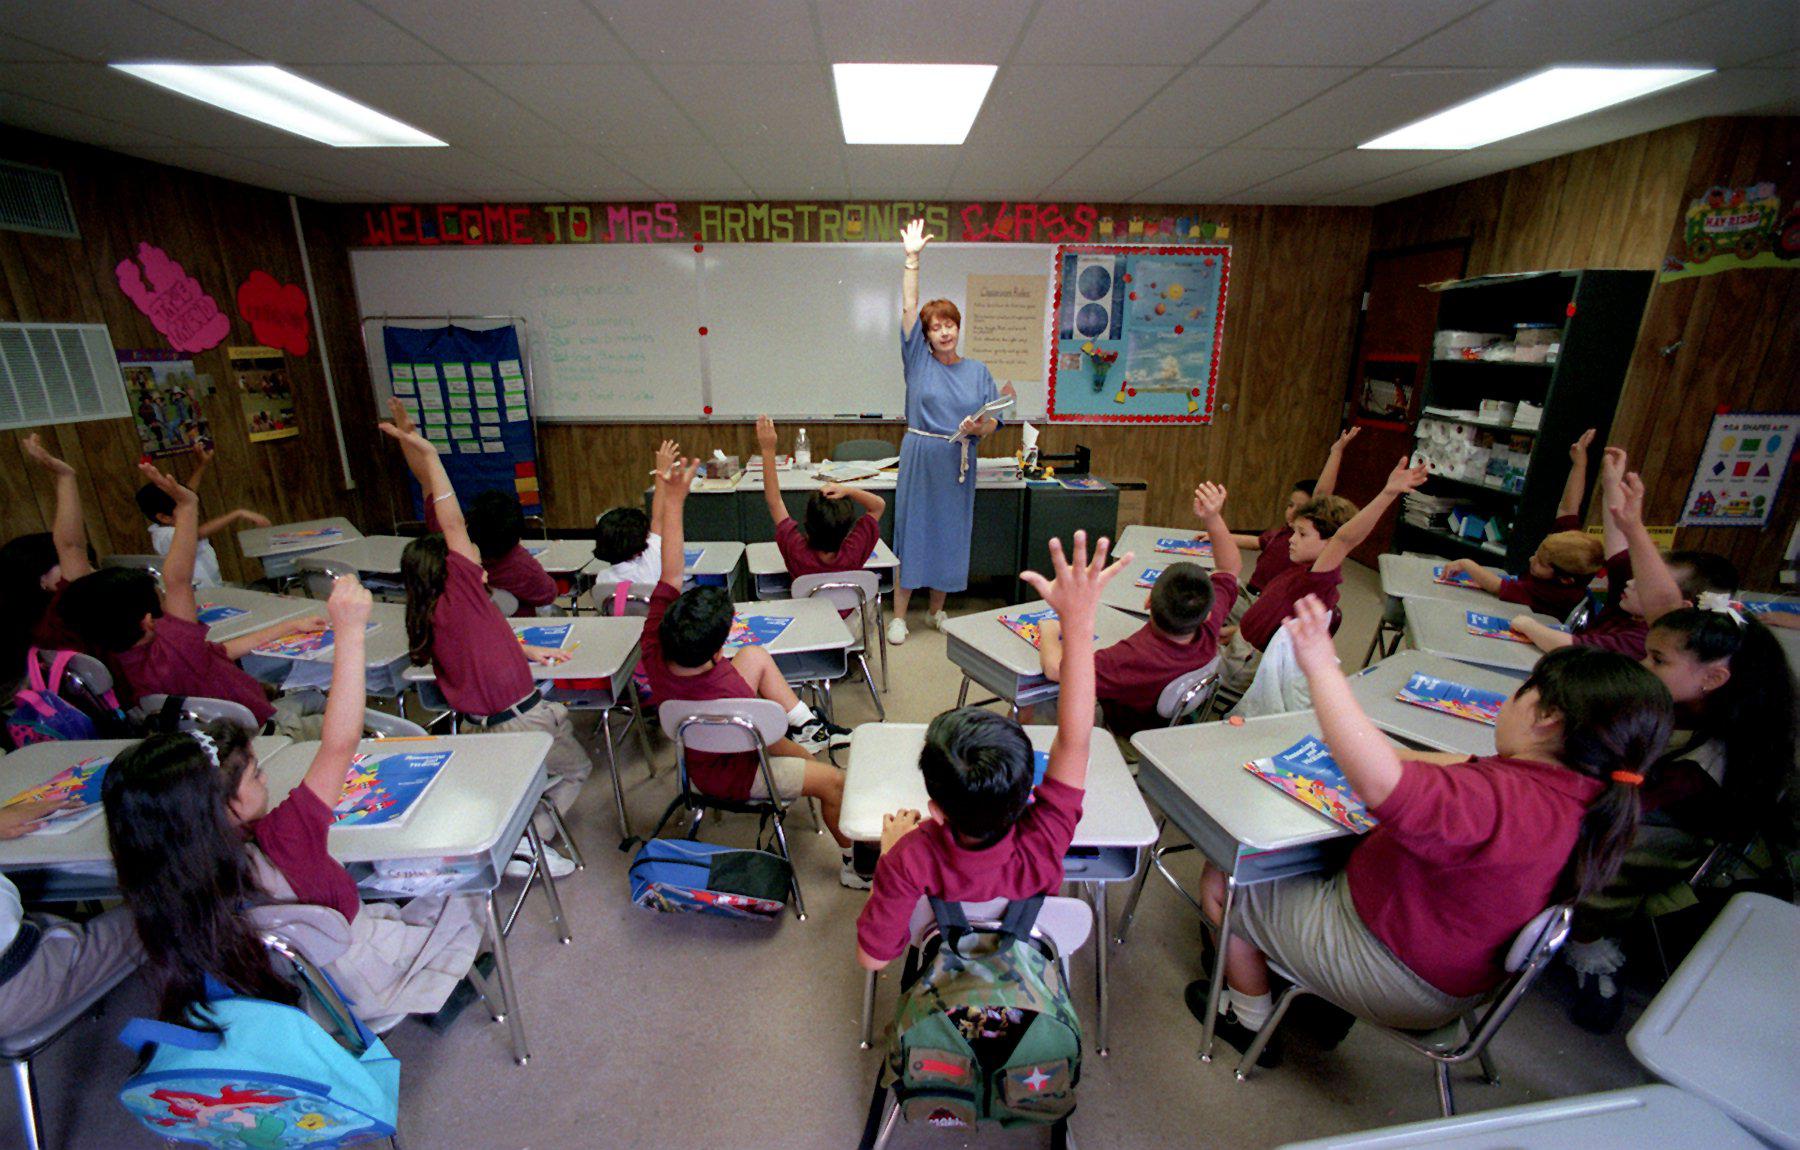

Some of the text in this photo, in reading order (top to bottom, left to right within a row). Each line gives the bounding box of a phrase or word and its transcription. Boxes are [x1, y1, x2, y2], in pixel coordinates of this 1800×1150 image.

[363, 203, 534, 245] WELCOME
[544, 206, 591, 242] TO
[607, 203, 685, 243] MRS.
[960, 203, 1098, 243] CLASS
